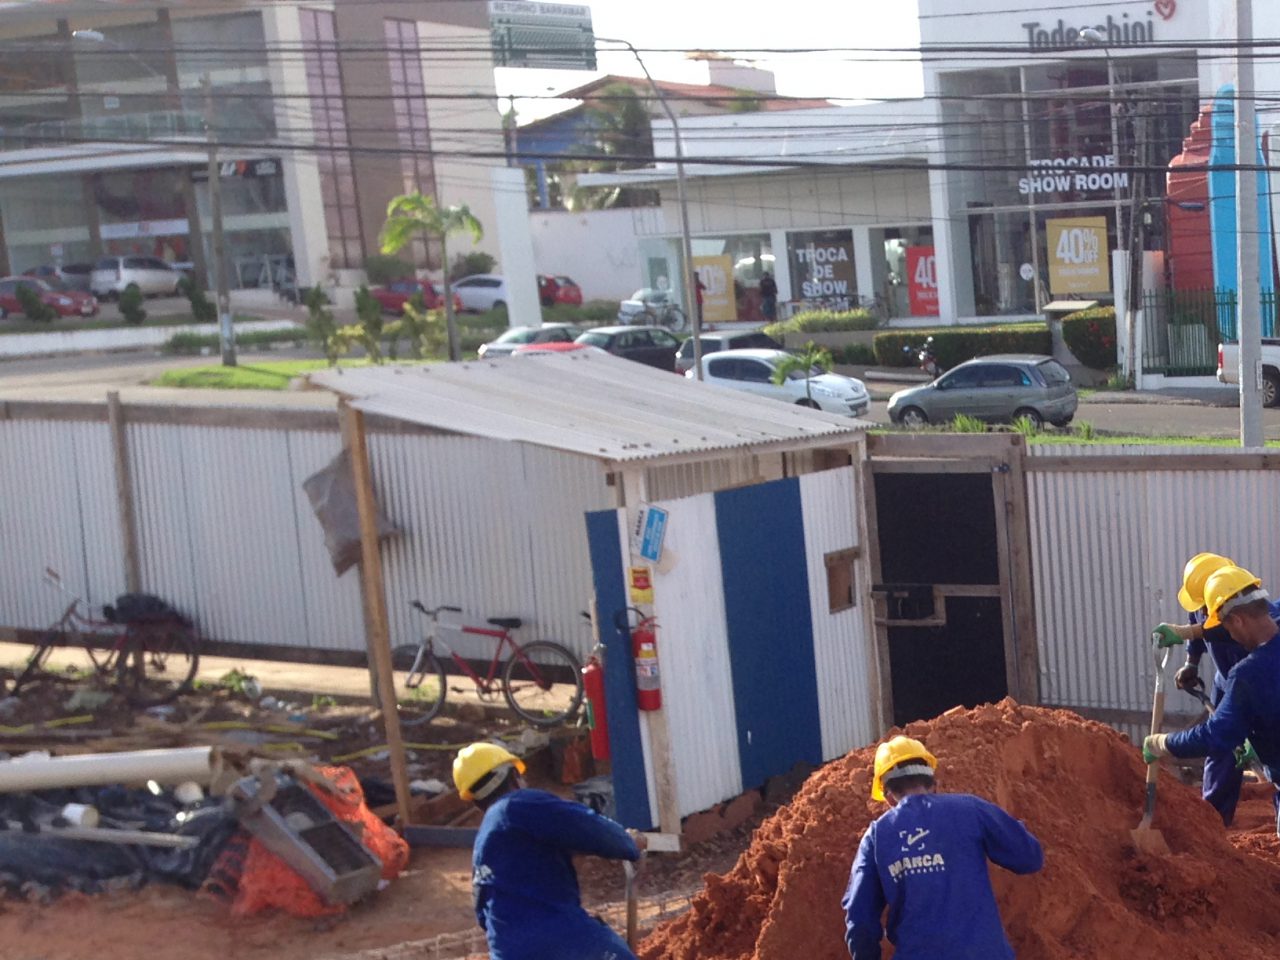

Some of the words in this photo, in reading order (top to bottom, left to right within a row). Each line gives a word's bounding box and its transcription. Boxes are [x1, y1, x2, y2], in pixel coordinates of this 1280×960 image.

[1021, 10, 1154, 50] Todehini
[1019, 176, 1070, 194] SHOW
[1076, 172, 1128, 190] ROOM
[796, 246, 848, 262] TROCA
[813, 264, 834, 278] DE
[802, 281, 847, 297] SHOW
[888, 853, 945, 877] MARCA
